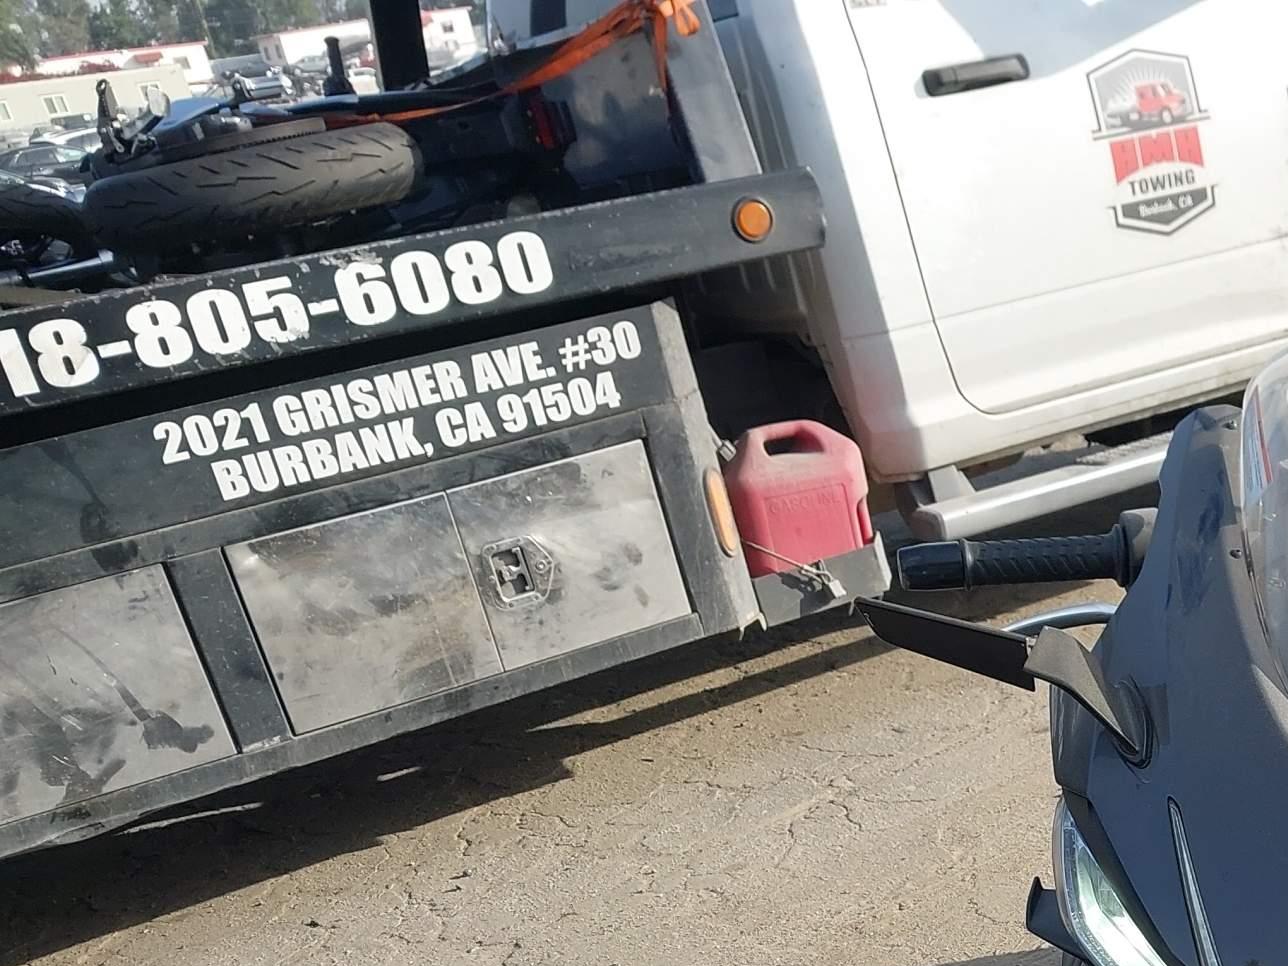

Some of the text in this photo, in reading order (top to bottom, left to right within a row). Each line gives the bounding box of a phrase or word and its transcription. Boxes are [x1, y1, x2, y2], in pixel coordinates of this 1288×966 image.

[1128, 169, 1196, 196] TOWING
[153, 320, 643, 465] 2021 GRISMER AVE. #30
[210, 371, 622, 501] BURBANK, CA 91504
